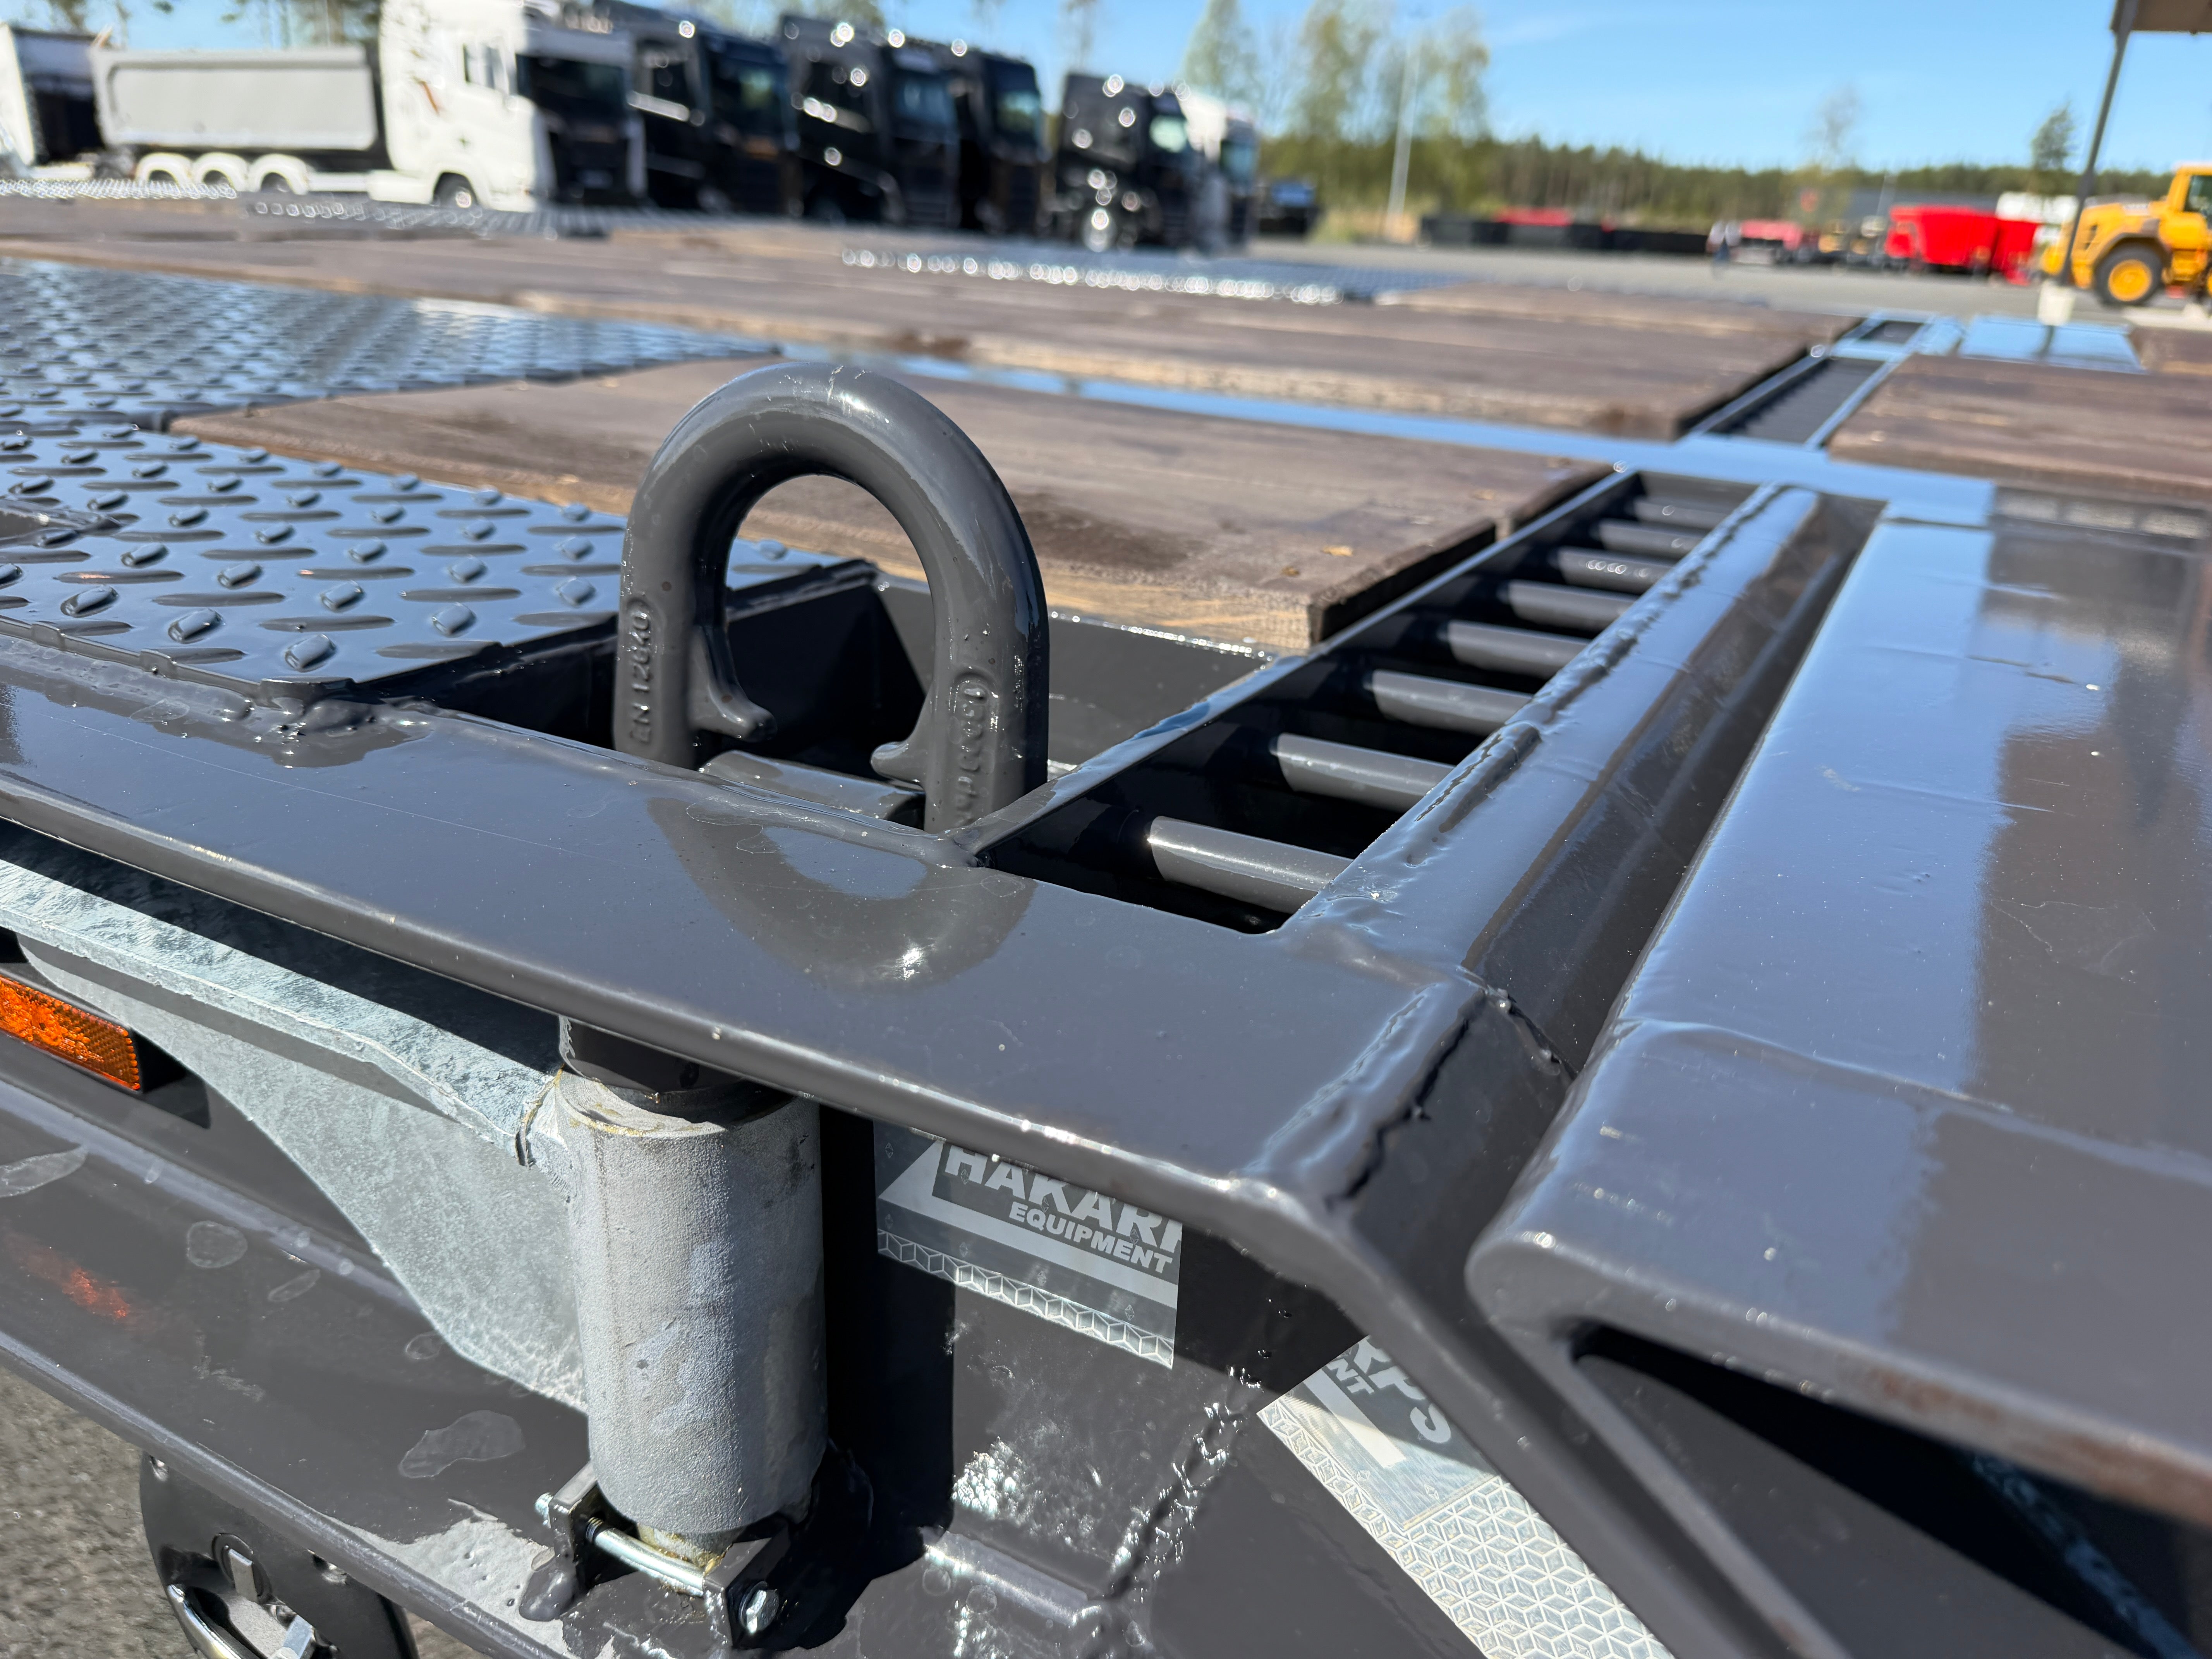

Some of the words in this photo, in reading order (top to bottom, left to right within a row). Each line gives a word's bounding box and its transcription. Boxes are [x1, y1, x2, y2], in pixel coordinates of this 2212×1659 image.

[631, 610, 652, 692] 12640
[630, 702, 652, 744] EN
[1009, 1201, 1173, 1273] EQUIPMENT
